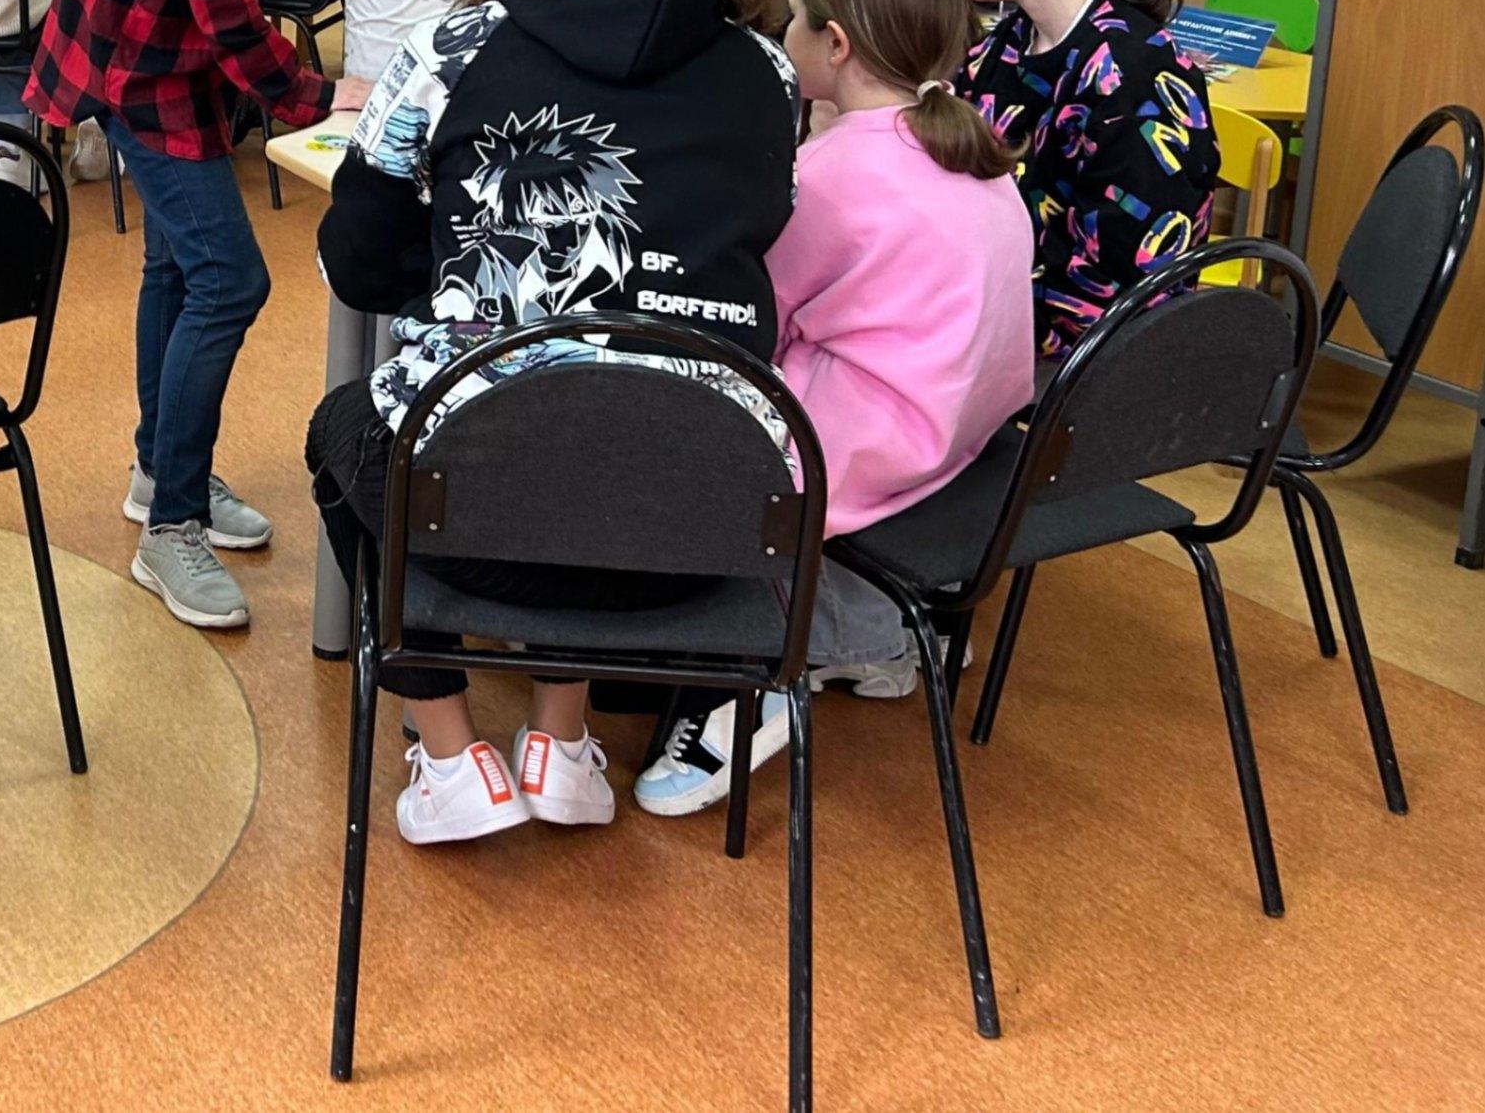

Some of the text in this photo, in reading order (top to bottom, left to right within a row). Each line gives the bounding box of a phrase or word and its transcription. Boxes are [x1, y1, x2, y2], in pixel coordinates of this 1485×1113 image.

[642, 251, 685, 275] BF.
[476, 750, 507, 794] PUMA
[524, 740, 546, 786] PUMA
